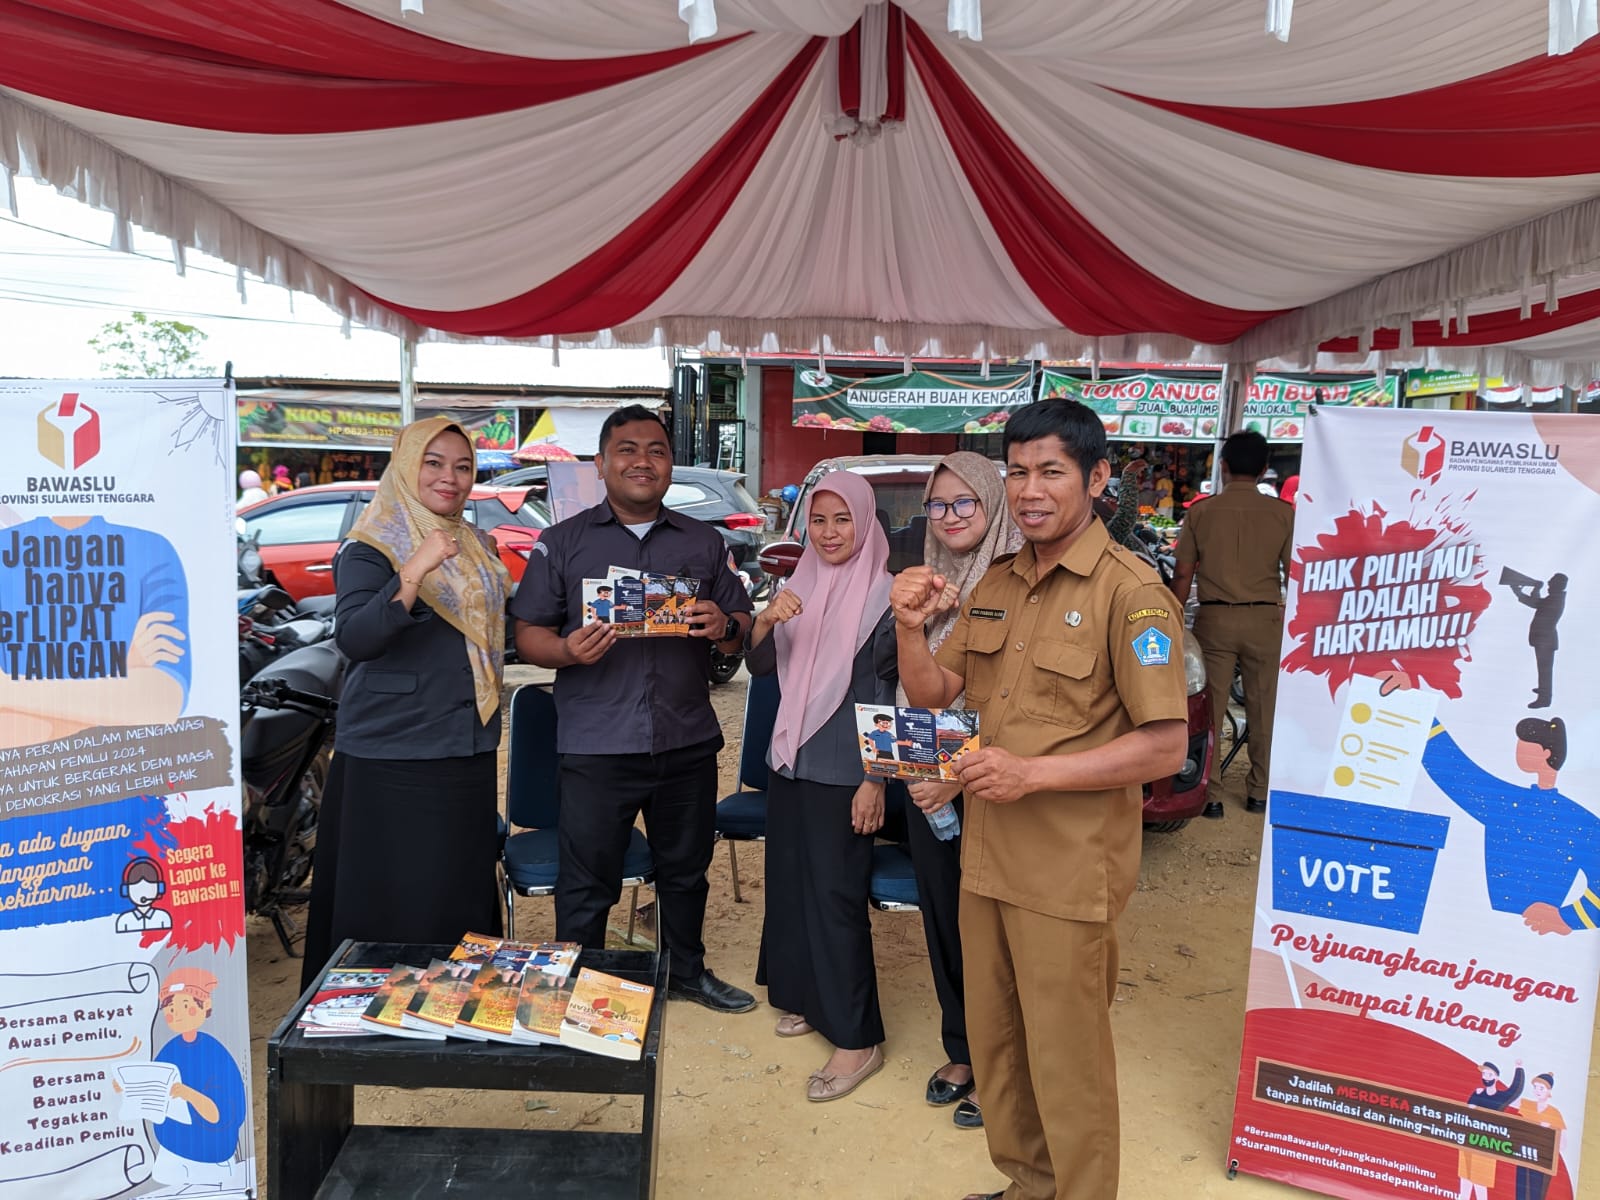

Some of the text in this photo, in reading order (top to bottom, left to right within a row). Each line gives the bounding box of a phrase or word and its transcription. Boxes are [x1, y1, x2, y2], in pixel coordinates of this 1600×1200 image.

[850, 389, 1029, 404] ANUGERAH BUAH KENDARI
[1081, 381, 1350, 401] TOKO ANUGAH BUAH
[284, 406, 401, 427] KIOS MARSY
[1138, 402, 1293, 415] JUAL BUAH IMP AN LOKAL
[1450, 440, 1560, 460] BAWASLU
[26, 476, 116, 492] BAWASLU
[1448, 464, 1556, 475] PROVINSI SULAWESI TENGGARA
[0, 493, 155, 504] OVINSI SULAWESI TENGGARA
[2, 530, 125, 571] Jangan
[1302, 544, 1475, 593] HAK PILIH MU
[25, 567, 126, 608] hanya
[1338, 582, 1440, 623] ADALAH
[0, 604, 116, 643] erLIPAT
[1313, 612, 1472, 657] HARTAMU!!!
[7, 640, 127, 681] TANGAN
[0, 719, 205, 762] NYA PERAN DALAM MENGAWASI
[0, 749, 215, 796] YA UNTUK BERGERAK DEMI MASA
[60, 751, 108, 768] PEMILU
[113, 747, 147, 760] 2024
[6, 790, 82, 812] DEMOKRASI
[87, 782, 121, 797] YANG
[126, 775, 164, 792] LEBIH
[168, 768, 199, 784] BAIK
[18, 831, 56, 855] ada
[60, 823, 132, 853] dugaan
[166, 843, 215, 866] Segera
[168, 861, 228, 886] Lapor ke
[1298, 855, 1396, 900] VOTE
[172, 882, 229, 907] Bawaslu
[1270, 923, 1579, 1004] Perjuangkan jangan
[0, 1004, 133, 1030] Bersama Rakyat
[1303, 980, 1522, 1048] sampai hilang
[8, 1033, 57, 1050] Awasi
[33, 1070, 106, 1089] Bersama
[33, 1090, 101, 1109] Bawaslu
[1288, 1075, 1511, 1139] Jadilah MERDEKA atas pilihanmu,
[26, 1111, 109, 1130] Tegakkan
[1265, 1086, 1300, 1104] tanpa
[1302, 1094, 1361, 1117] intimidasi
[1363, 1109, 1386, 1123] dan
[1388, 1114, 1466, 1145] iming-iming
[0, 1125, 135, 1155] Keadilan Pemilu
[1244, 1124, 1437, 1179] #BersamaBawasluPerjuangkanhakpilihmu
